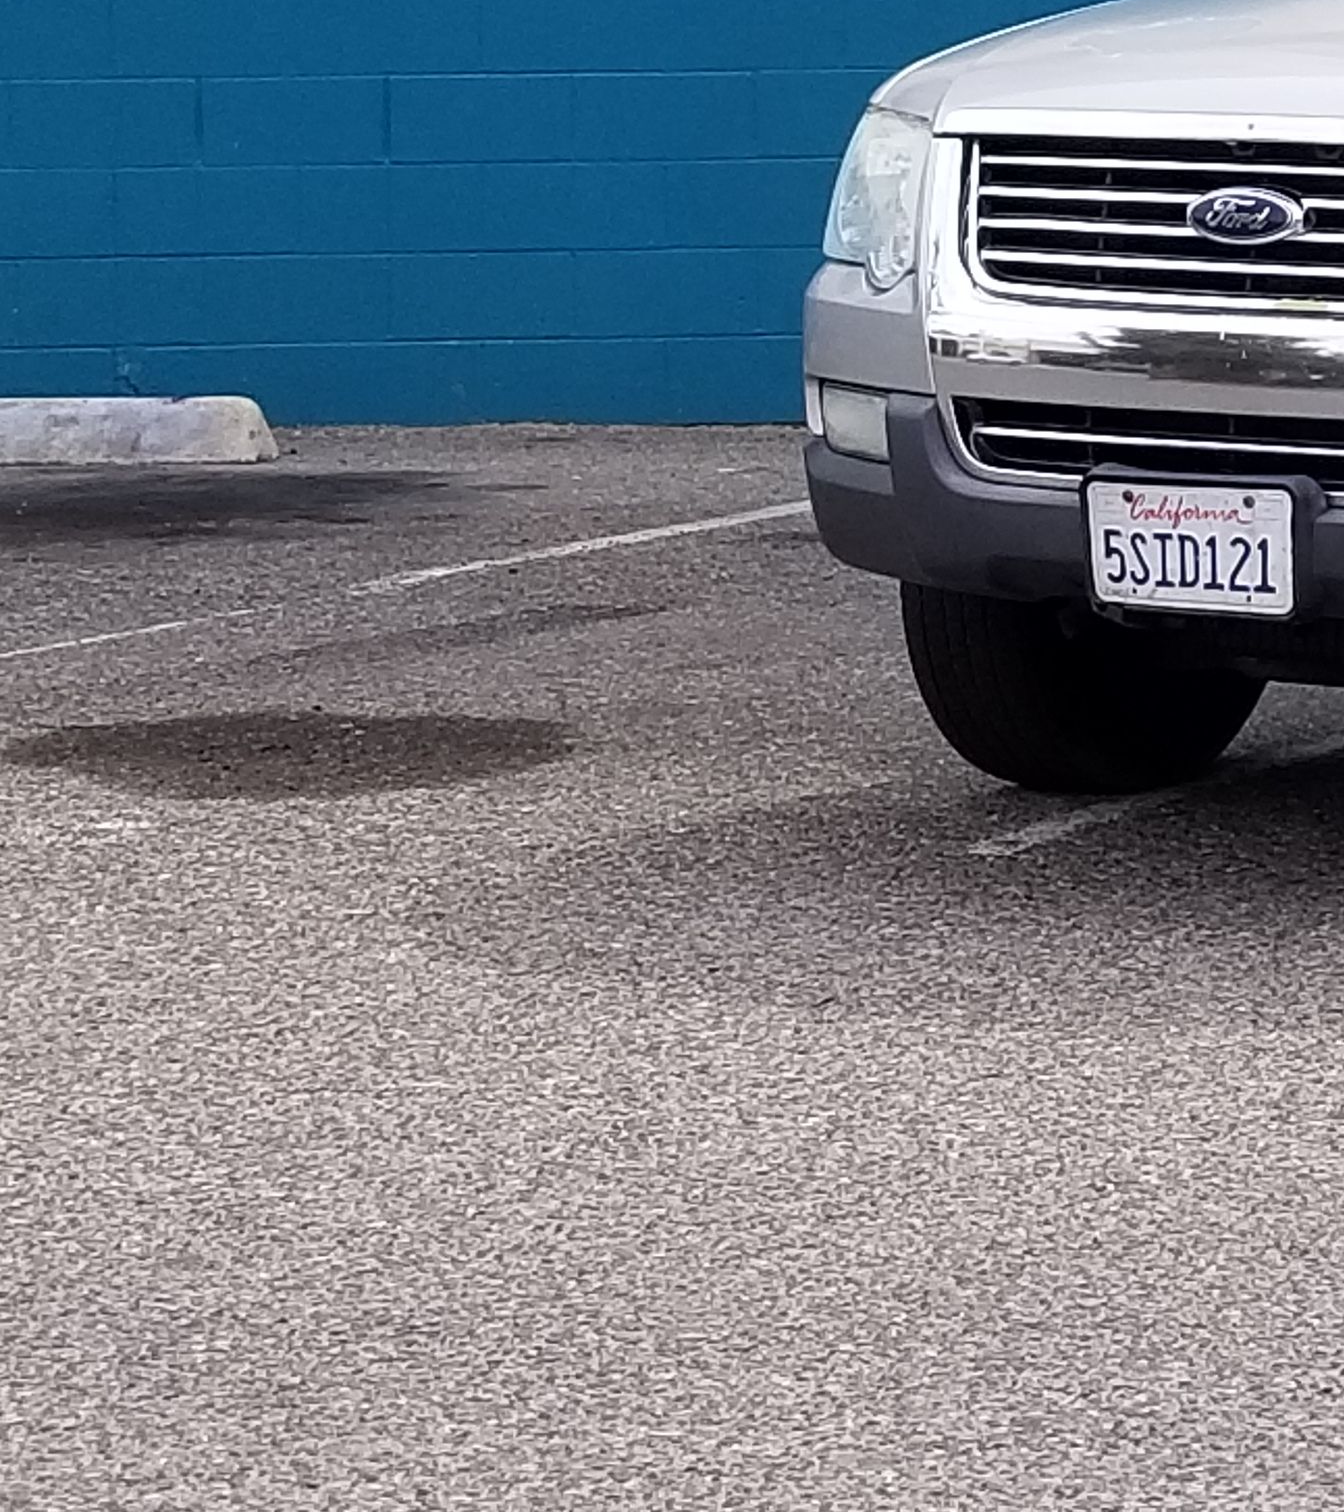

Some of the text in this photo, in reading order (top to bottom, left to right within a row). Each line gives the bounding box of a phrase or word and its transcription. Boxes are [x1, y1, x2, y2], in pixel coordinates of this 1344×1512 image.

[1205, 197, 1270, 230] Ford
[1130, 494, 1252, 528] California
[1104, 529, 1276, 593] 5SID121
